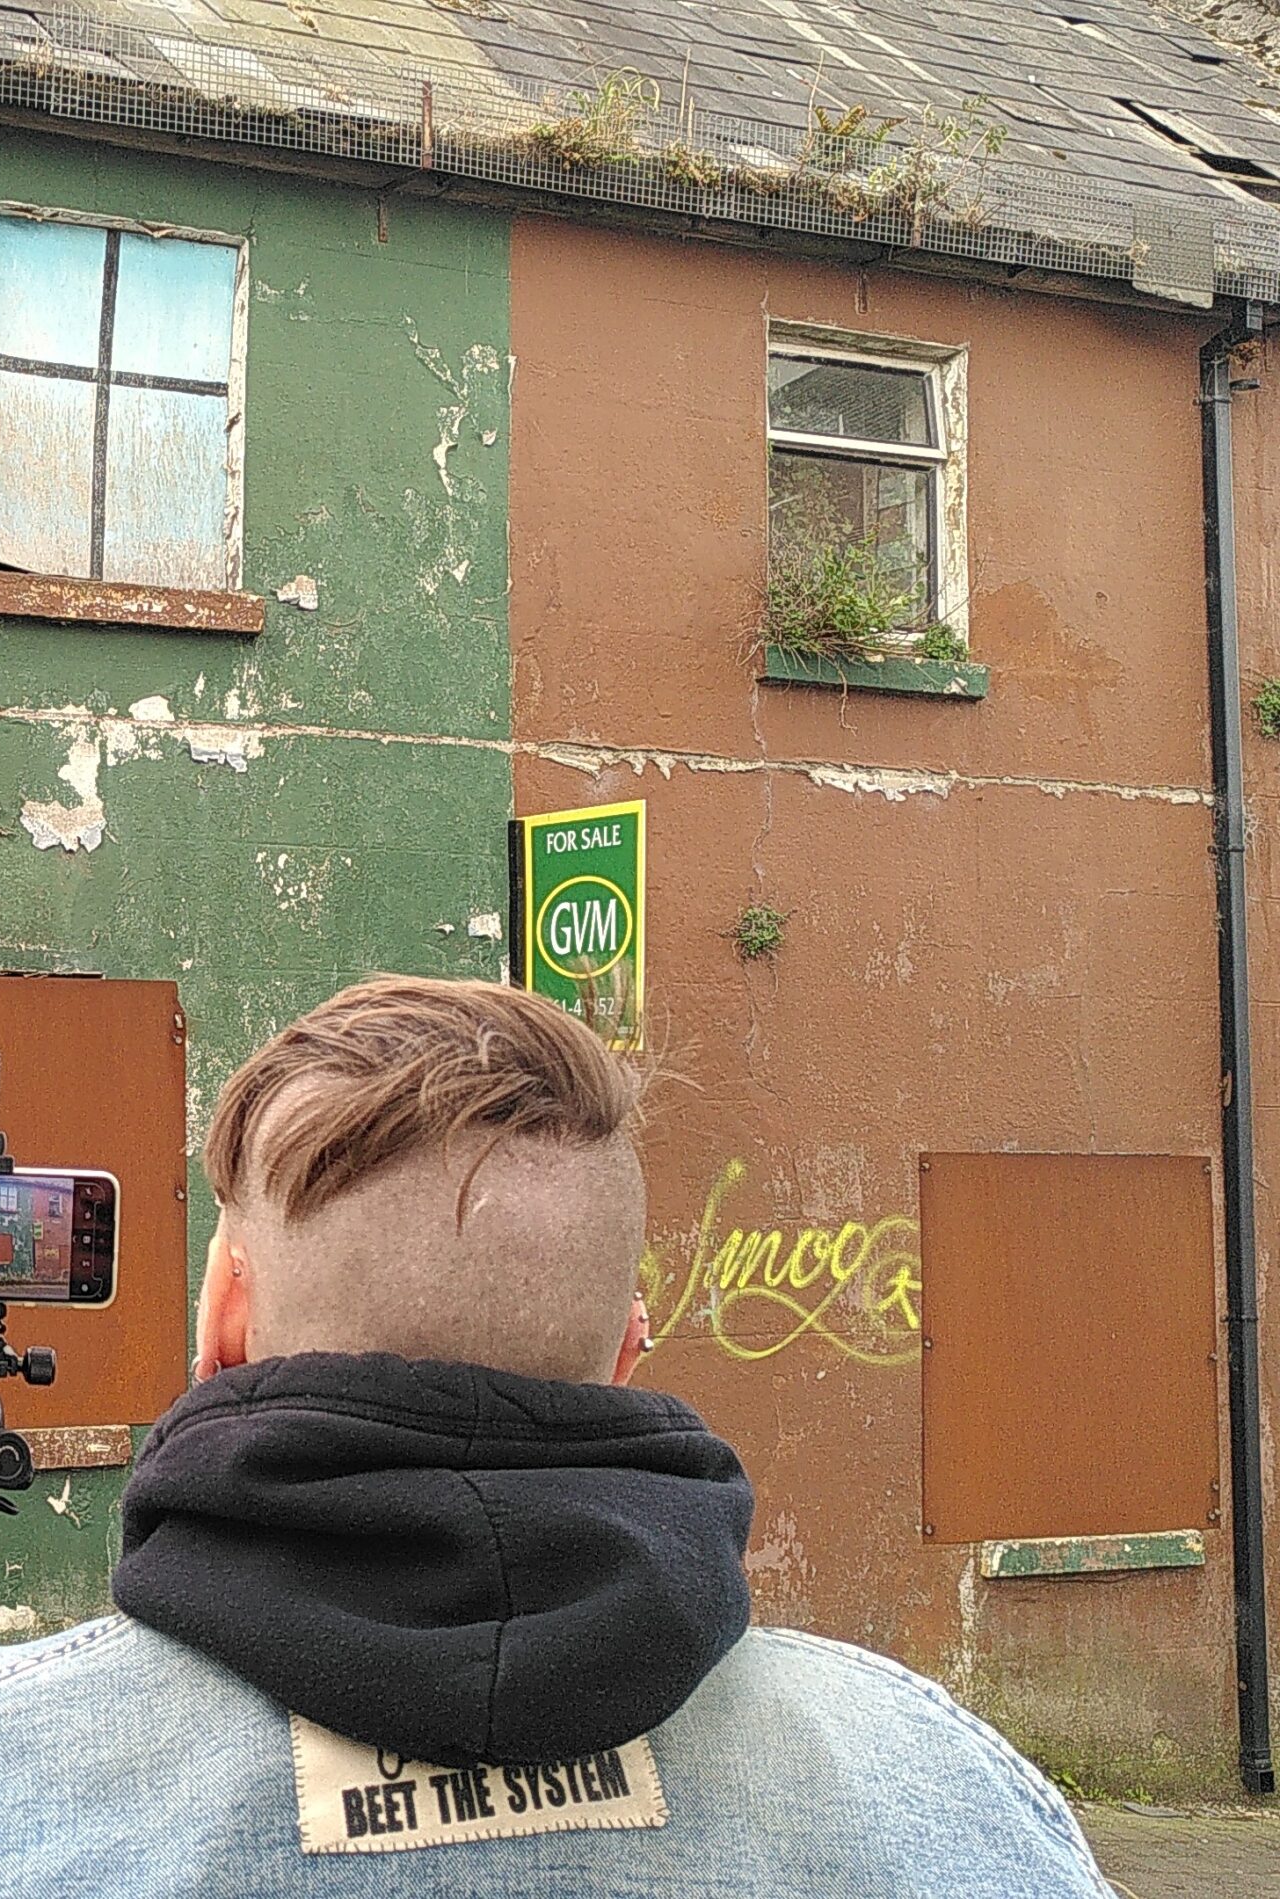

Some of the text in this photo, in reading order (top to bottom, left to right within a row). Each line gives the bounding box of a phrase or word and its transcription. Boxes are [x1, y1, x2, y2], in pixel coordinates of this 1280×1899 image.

[546, 824, 622, 854] FOR SALE
[550, 898, 617, 955] GVM
[342, 1748, 631, 1839] BEET THE SYSTEM
